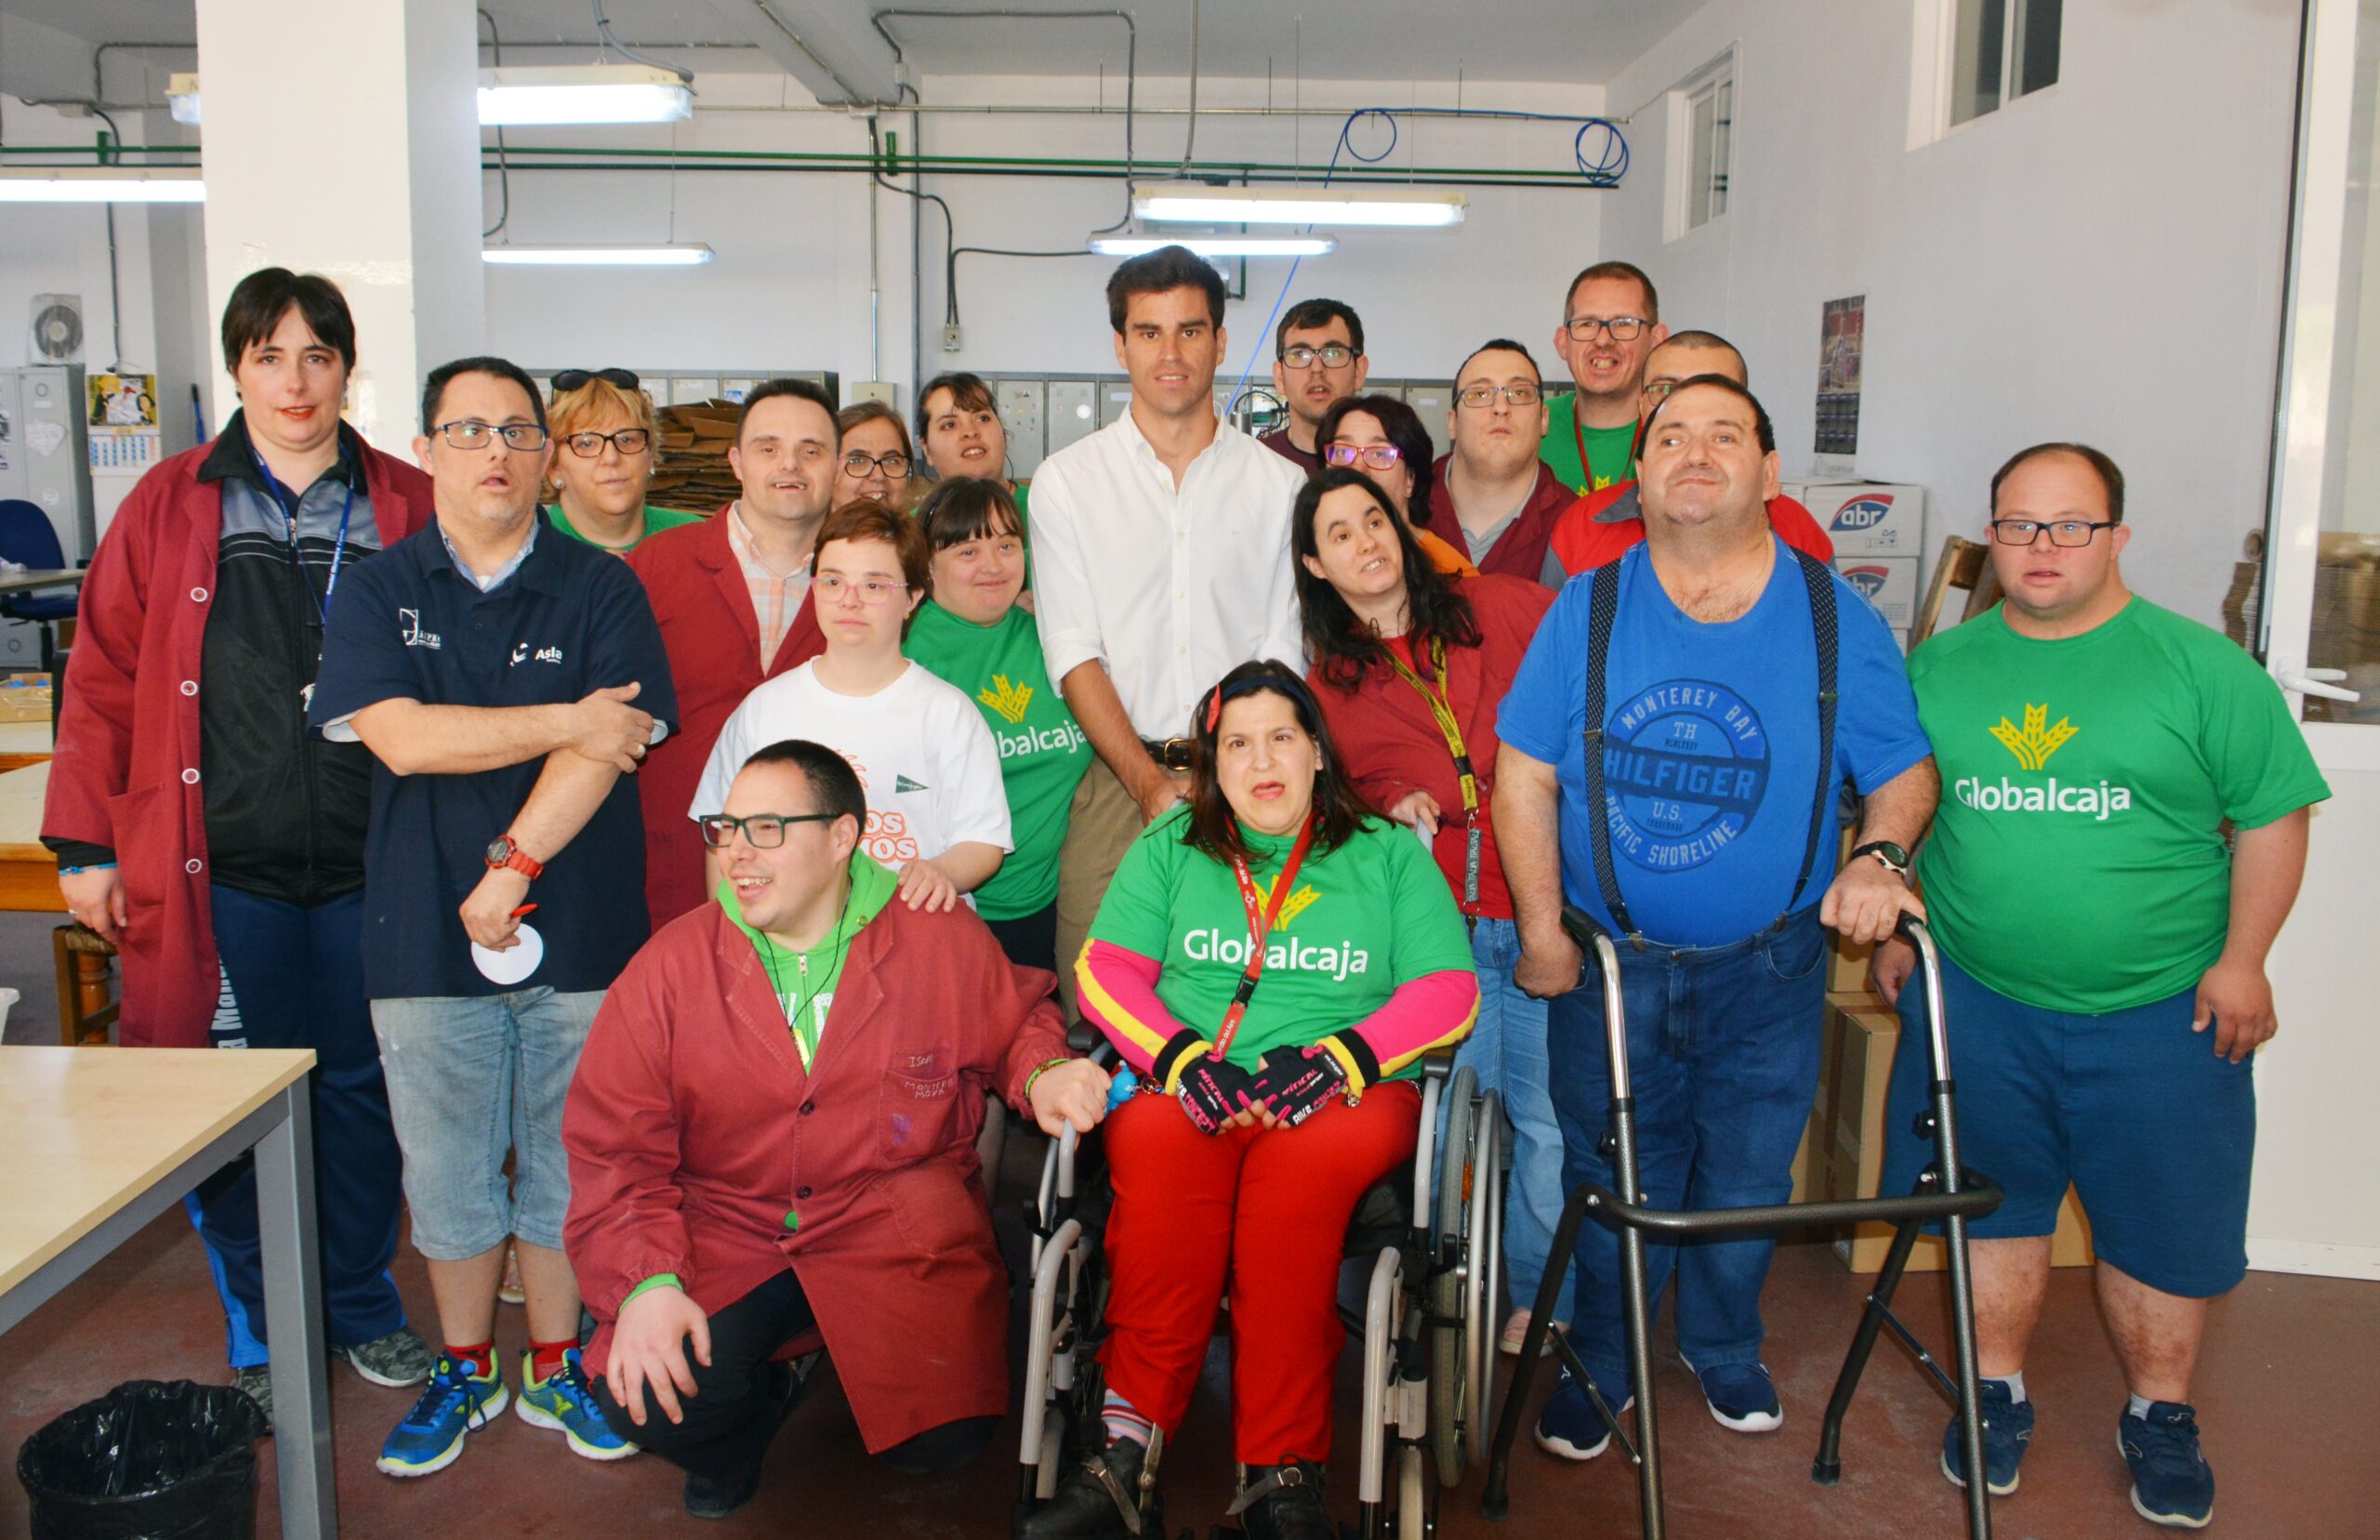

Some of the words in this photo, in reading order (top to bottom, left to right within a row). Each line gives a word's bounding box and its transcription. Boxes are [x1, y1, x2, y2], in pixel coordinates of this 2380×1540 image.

[1841, 505, 1882, 526] abr
[1621, 687, 1718, 730] MONTEREY
[1725, 704, 1757, 741] BAY
[1674, 721, 1698, 739] TH
[997, 719, 1088, 758] balcaja
[1604, 748, 1756, 799] HILFIGER
[1653, 802, 1683, 821] U.S.
[1955, 777, 2131, 821] Globalcaja
[864, 810, 906, 836] OS
[1606, 796, 1643, 854] PACIFIC
[1647, 820, 1738, 865] SHORELINE
[857, 837, 919, 863] OS
